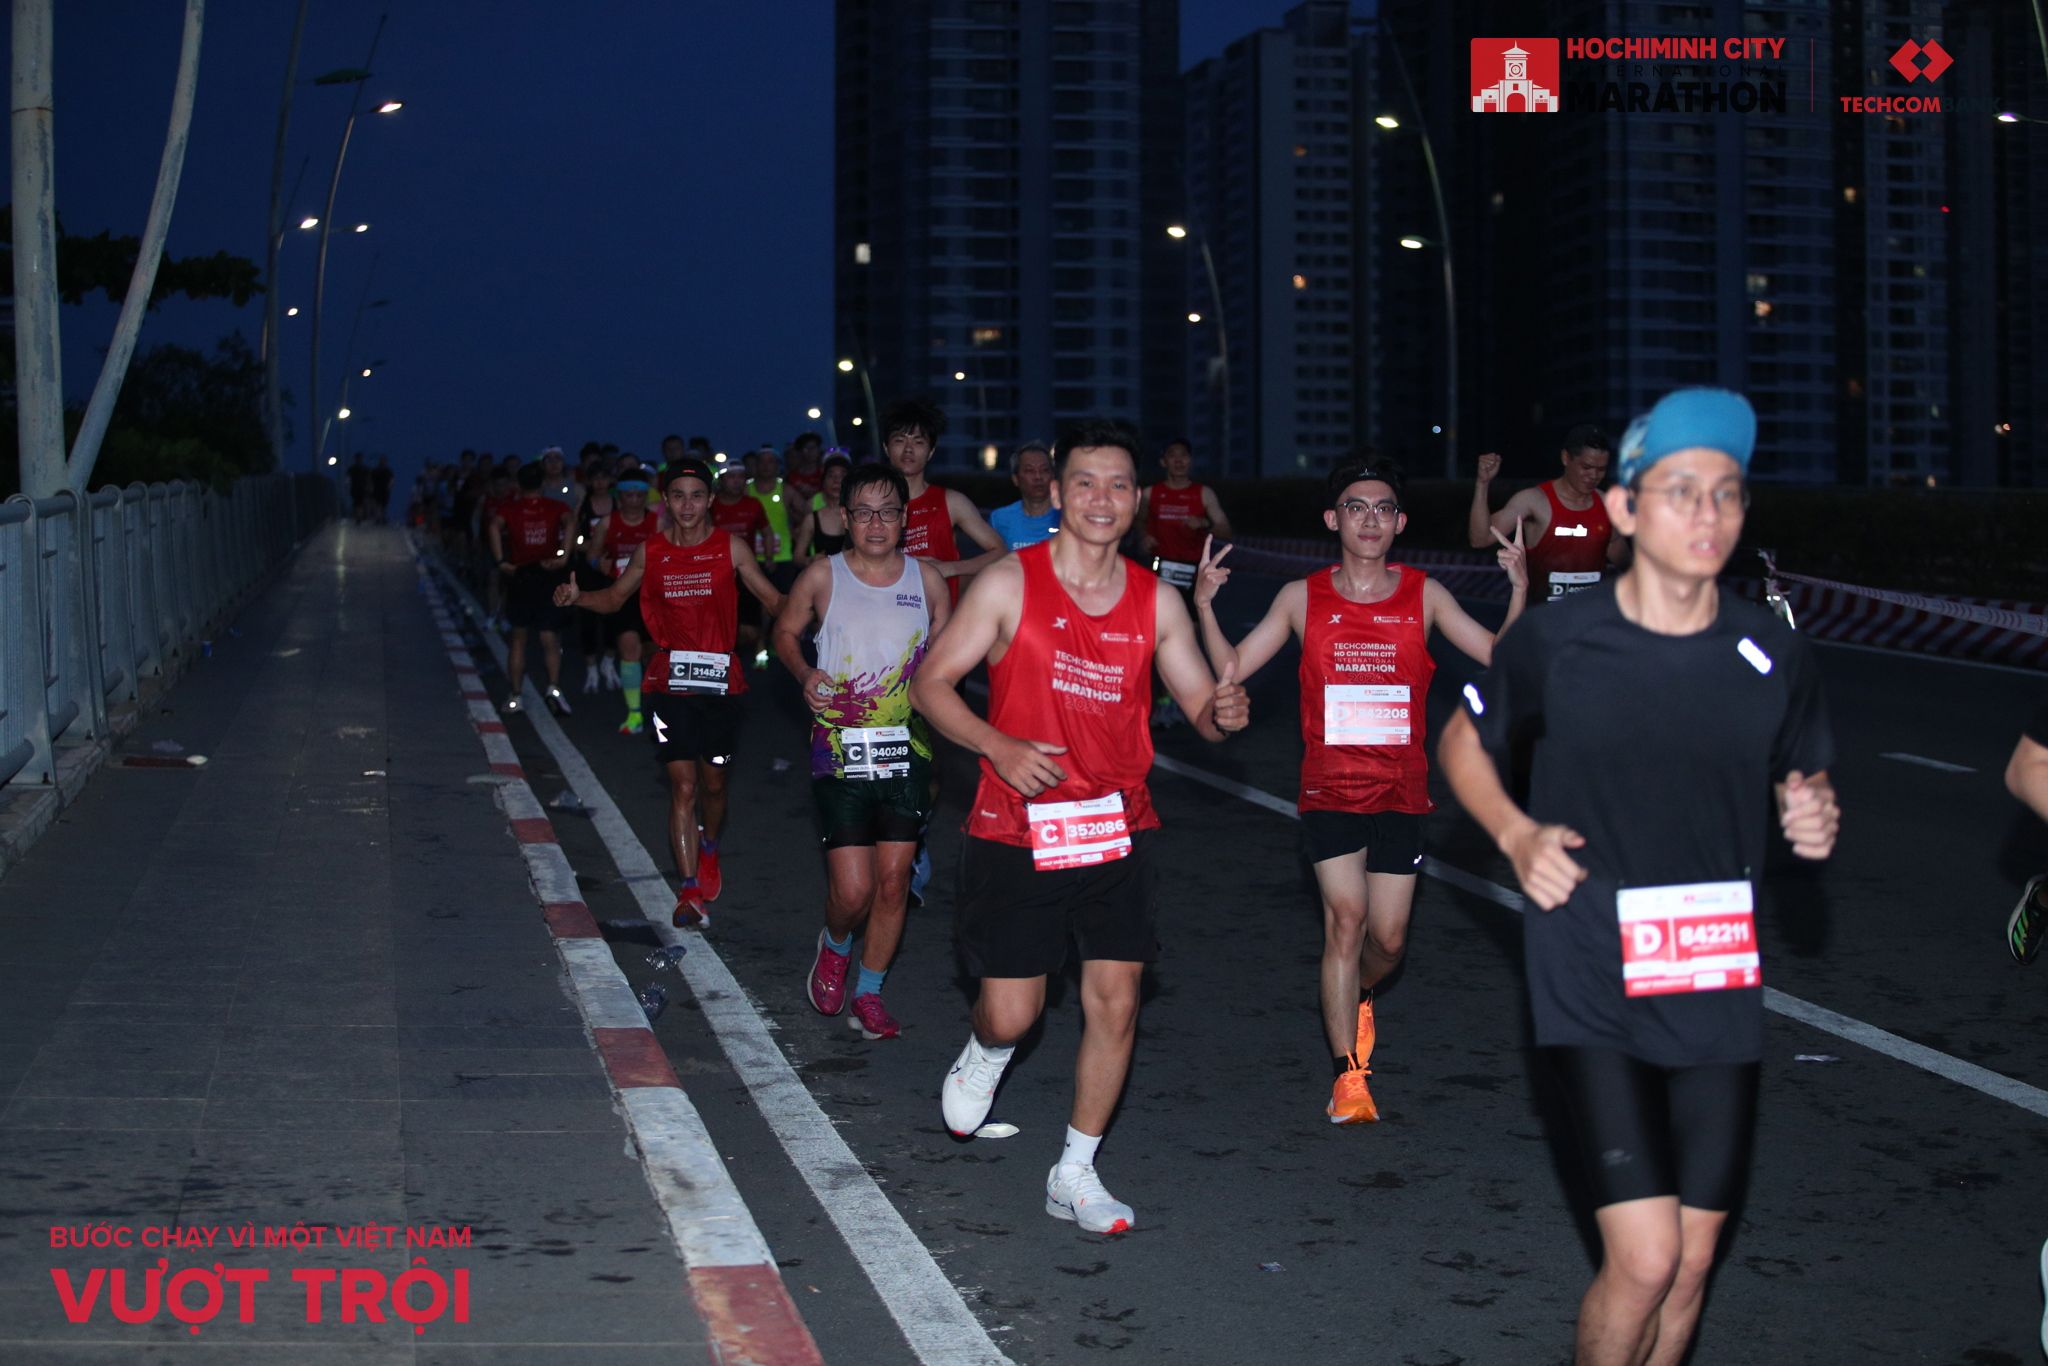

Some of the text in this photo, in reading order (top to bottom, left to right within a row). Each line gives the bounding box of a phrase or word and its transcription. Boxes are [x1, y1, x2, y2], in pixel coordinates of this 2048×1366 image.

[663, 572, 712, 581] TECHCOMBANK
[664, 589, 713, 598] MARATHON
[1552, 584, 1564, 595] D
[896, 601, 922, 609] RUNNERS
[1334, 642, 1397, 651] TECHCOMBANK
[674, 664, 727, 678] C 314827
[1054, 661, 1067, 671] HO
[1104, 675, 1123, 684] CITY
[1335, 663, 1396, 673] MARATHON
[1052, 678, 1122, 703] MARATHON
[848, 746, 908, 761] C 940249
[1040, 819, 1127, 844] C 352086
[1633, 922, 1750, 956] D 842211
